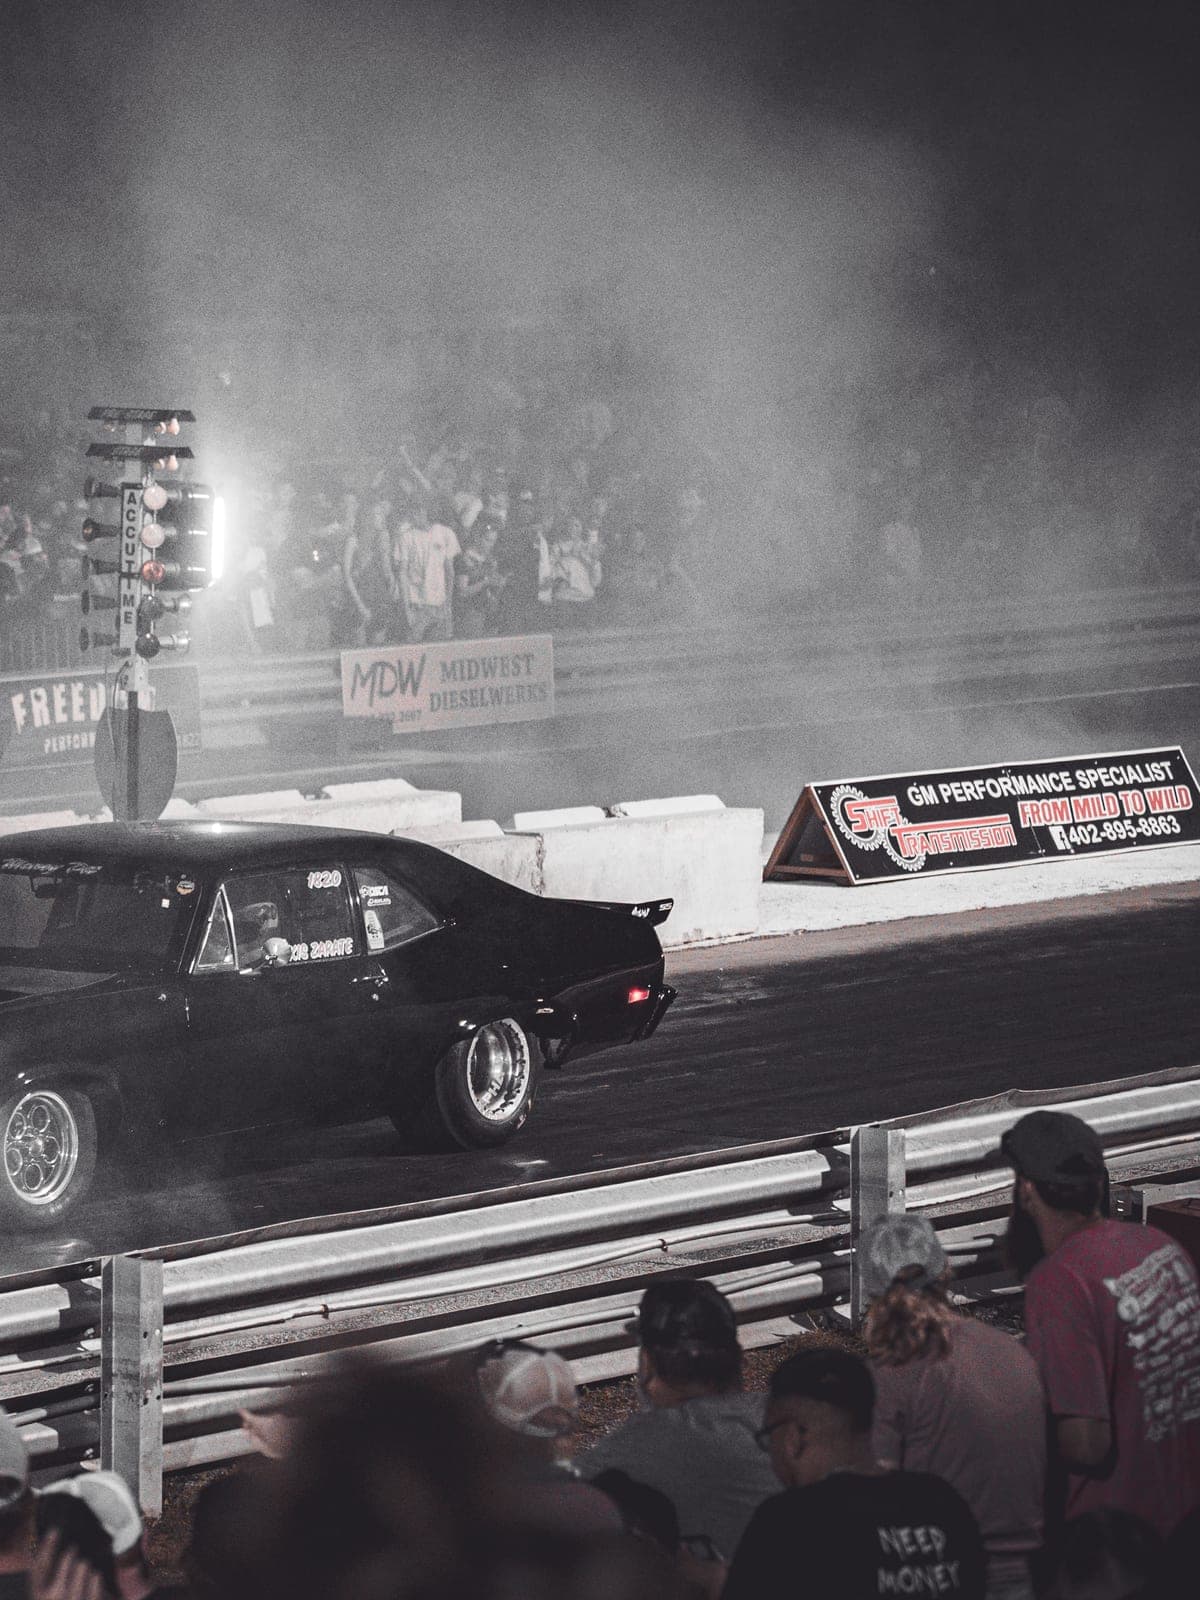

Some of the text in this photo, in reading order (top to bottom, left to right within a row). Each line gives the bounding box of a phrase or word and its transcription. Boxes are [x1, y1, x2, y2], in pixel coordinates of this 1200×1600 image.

[351, 653, 426, 708] MDW
[439, 654, 535, 683] MIDWEST
[11, 682, 156, 736] FREED
[429, 683, 548, 713] DIESELWERKS
[907, 761, 1174, 806] GM PERFORMANCE SPECIALIST
[845, 796, 900, 832] SHIFT
[1017, 784, 1193, 828] FROM MILD TO WILD
[1069, 815, 1182, 846] 402-895-8863
[306, 870, 342, 889] 1820
[289, 937, 353, 962] XIS ZARATE
[878, 1525, 946, 1561] NEED
[878, 1561, 960, 1598] MONEY
